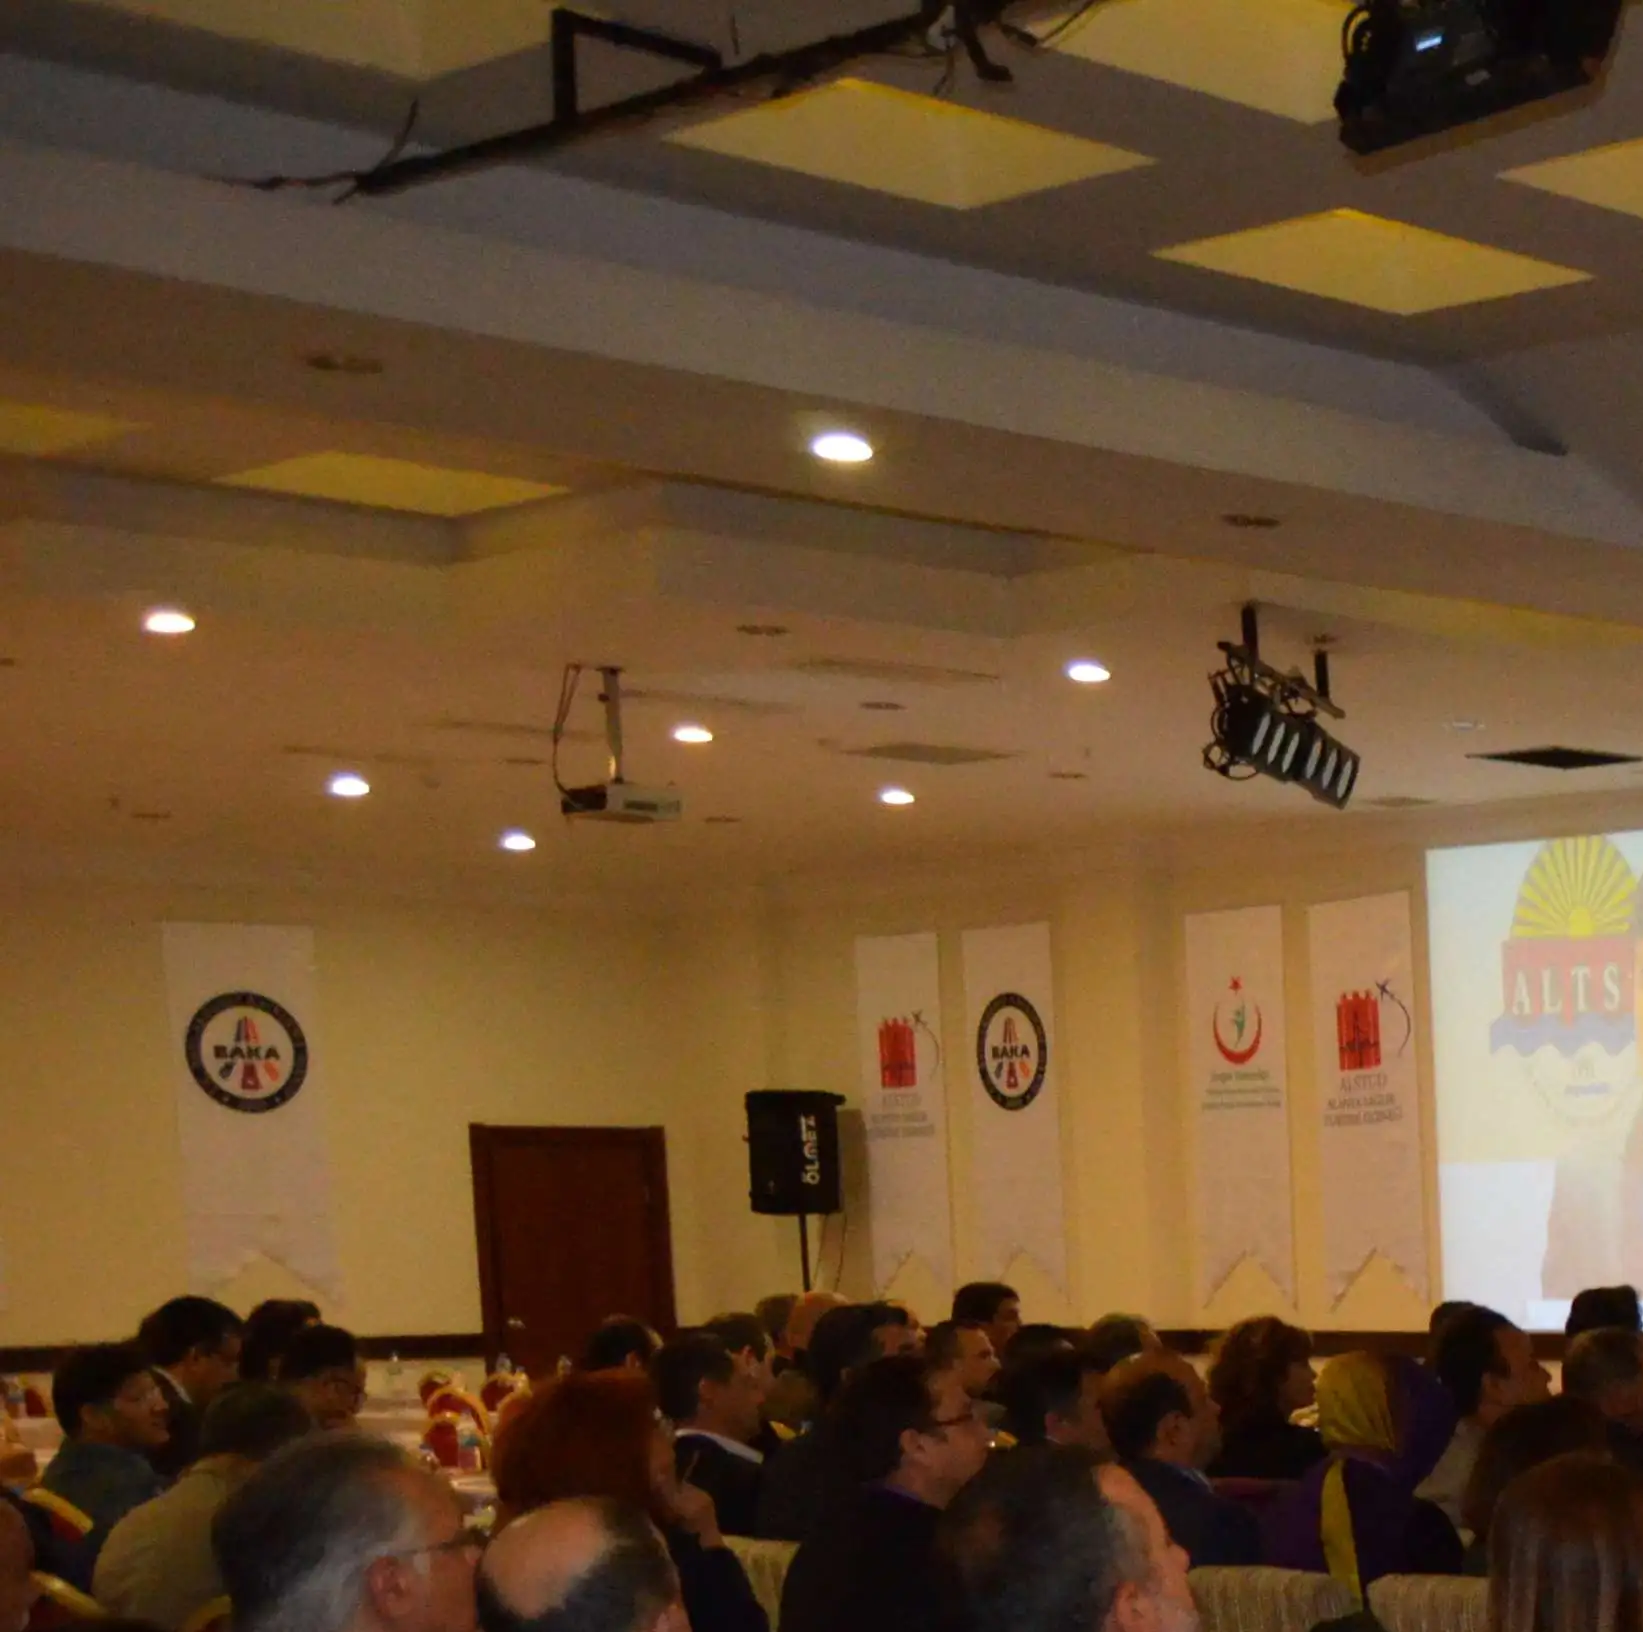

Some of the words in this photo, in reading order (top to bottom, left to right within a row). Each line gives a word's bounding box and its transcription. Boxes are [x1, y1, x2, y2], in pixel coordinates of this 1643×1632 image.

[1511, 962, 1633, 1016] ALTS
[213, 1044, 281, 1060] BAKA
[991, 1043, 1031, 1061] BAKA
